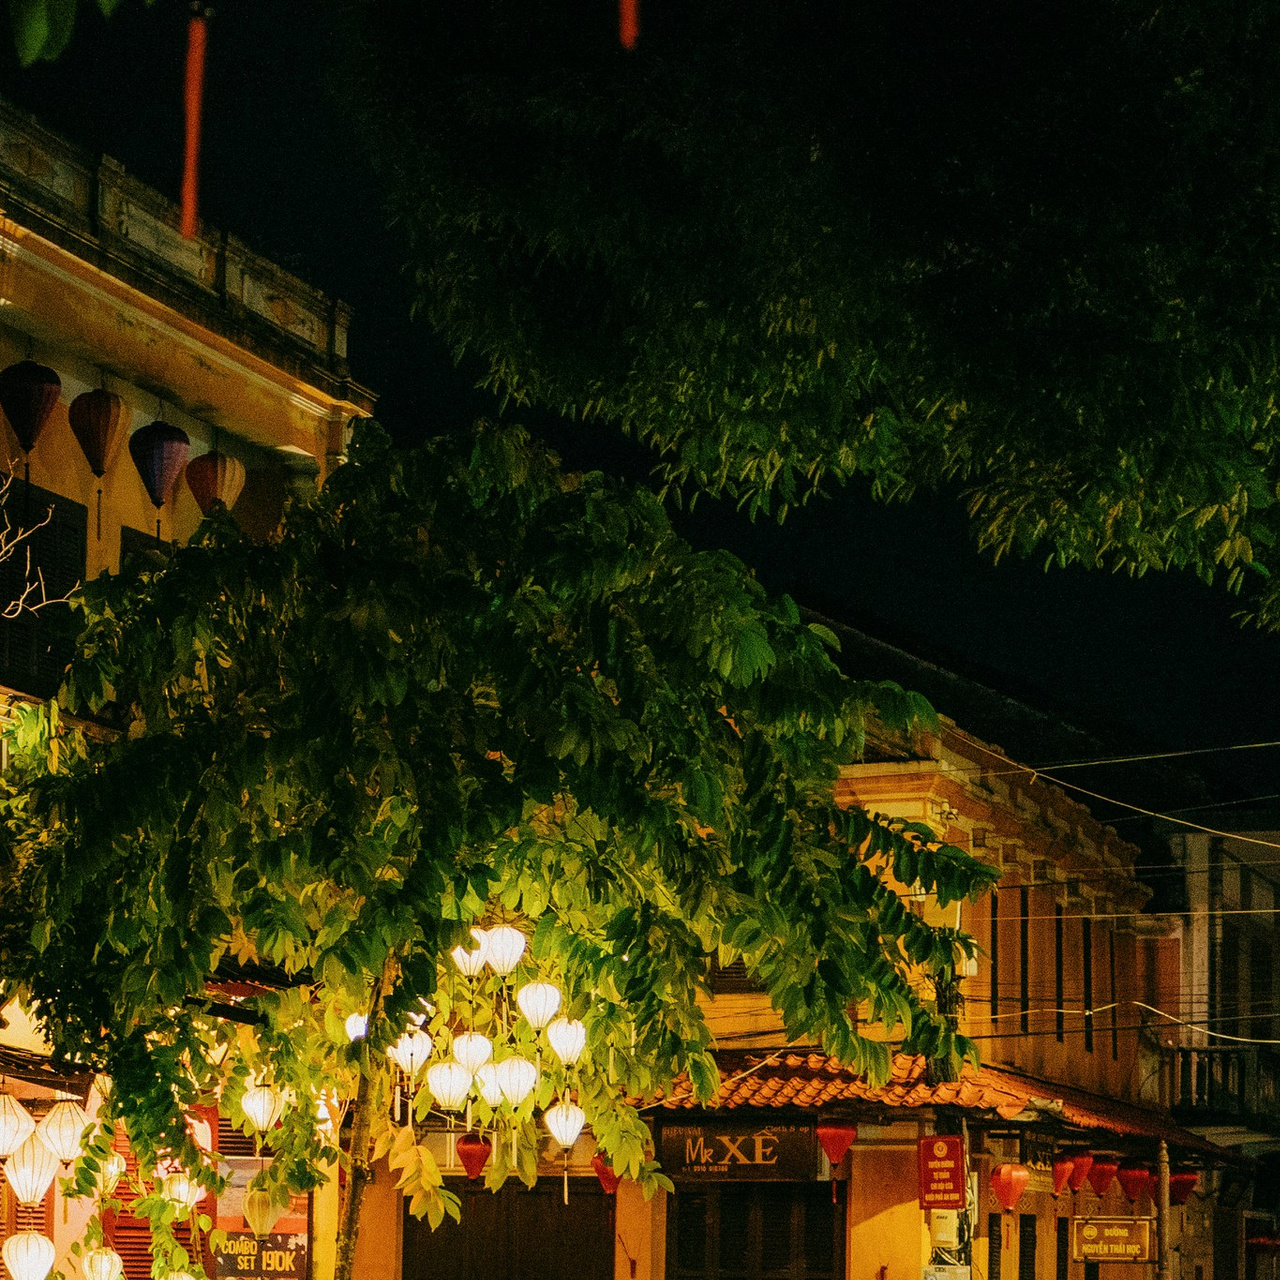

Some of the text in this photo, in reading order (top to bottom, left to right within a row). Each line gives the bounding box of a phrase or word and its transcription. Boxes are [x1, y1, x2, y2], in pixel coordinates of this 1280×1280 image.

[715, 1129, 780, 1165] XÊ
[1104, 1226, 1129, 1237] ĐƯỜNG
[221, 1240, 258, 1255] COMBO
[1110, 1242, 1126, 1254] THÁI
[1126, 1244, 1141, 1256] HỌC
[237, 1256, 256, 1270] SET
[261, 1250, 296, 1272] 190K
